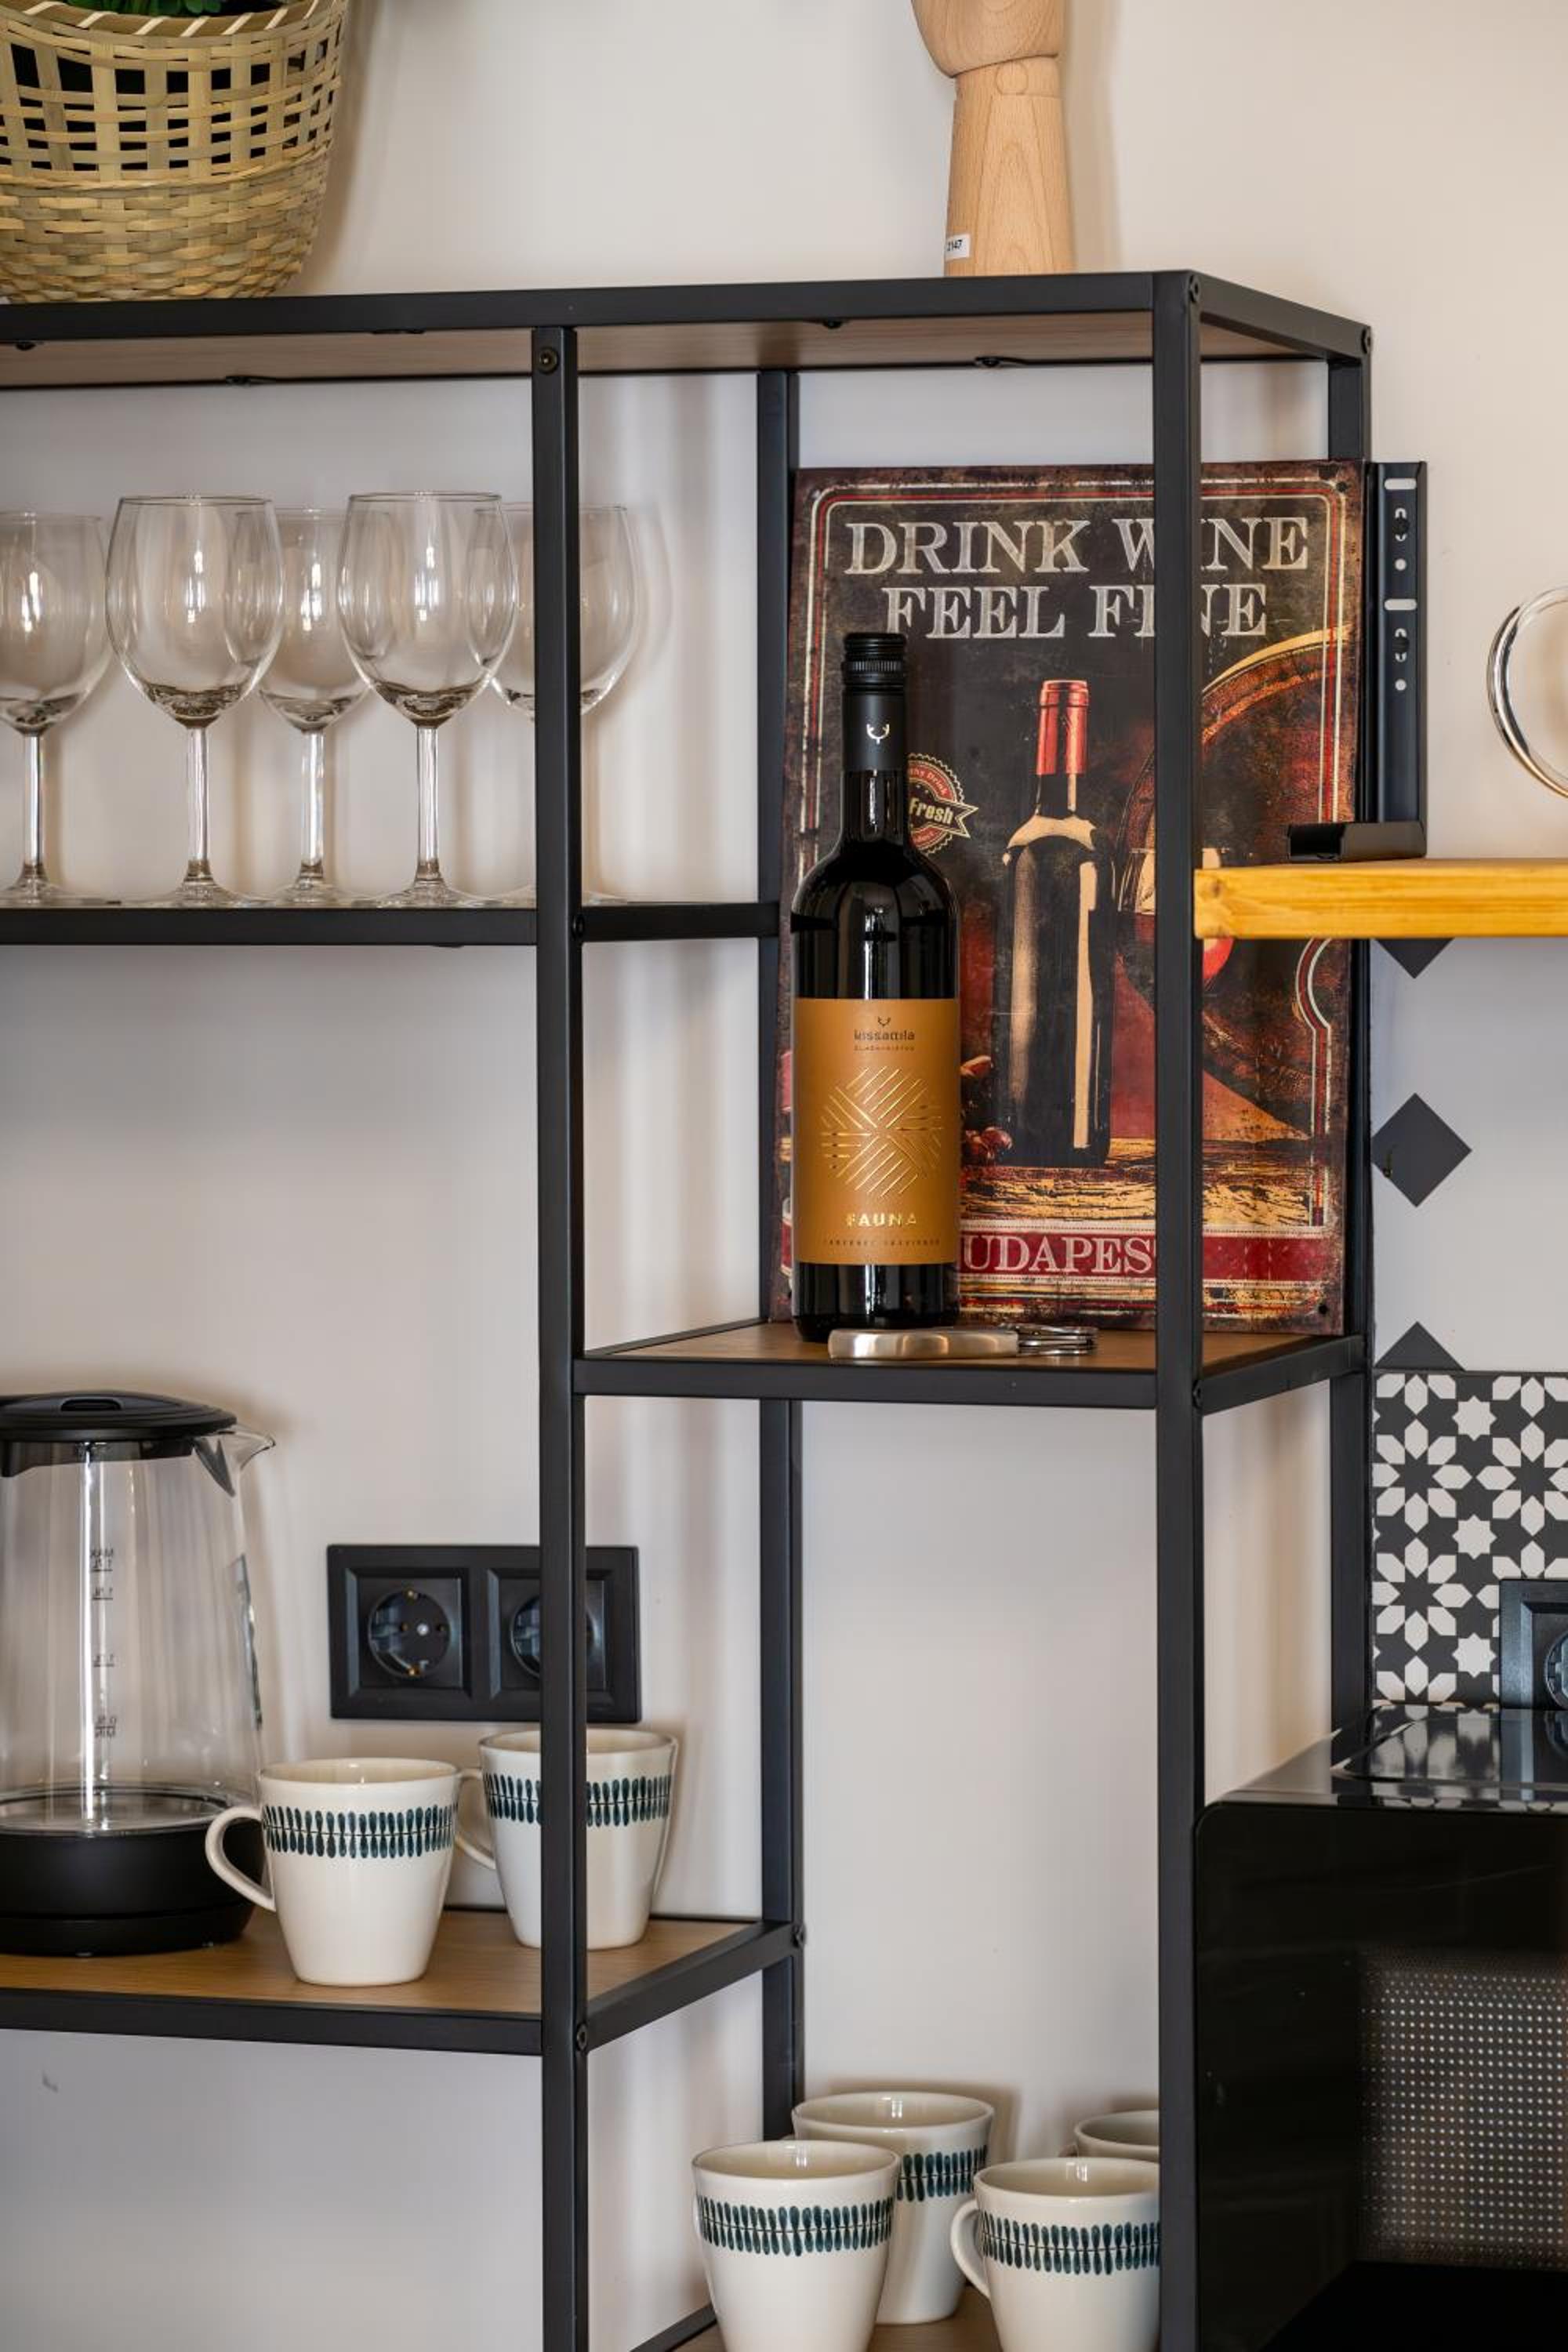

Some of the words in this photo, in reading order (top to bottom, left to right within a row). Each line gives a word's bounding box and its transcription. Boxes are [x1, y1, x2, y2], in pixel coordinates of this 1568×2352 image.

[844, 520, 1091, 575] DRINK
[1111, 517, 1308, 572] WNE
[881, 586, 1065, 639] FEEL
[909, 797, 954, 825] Fresh
[846, 1212, 917, 1227] FAUNA
[960, 1234, 1156, 1275] UDAPES
